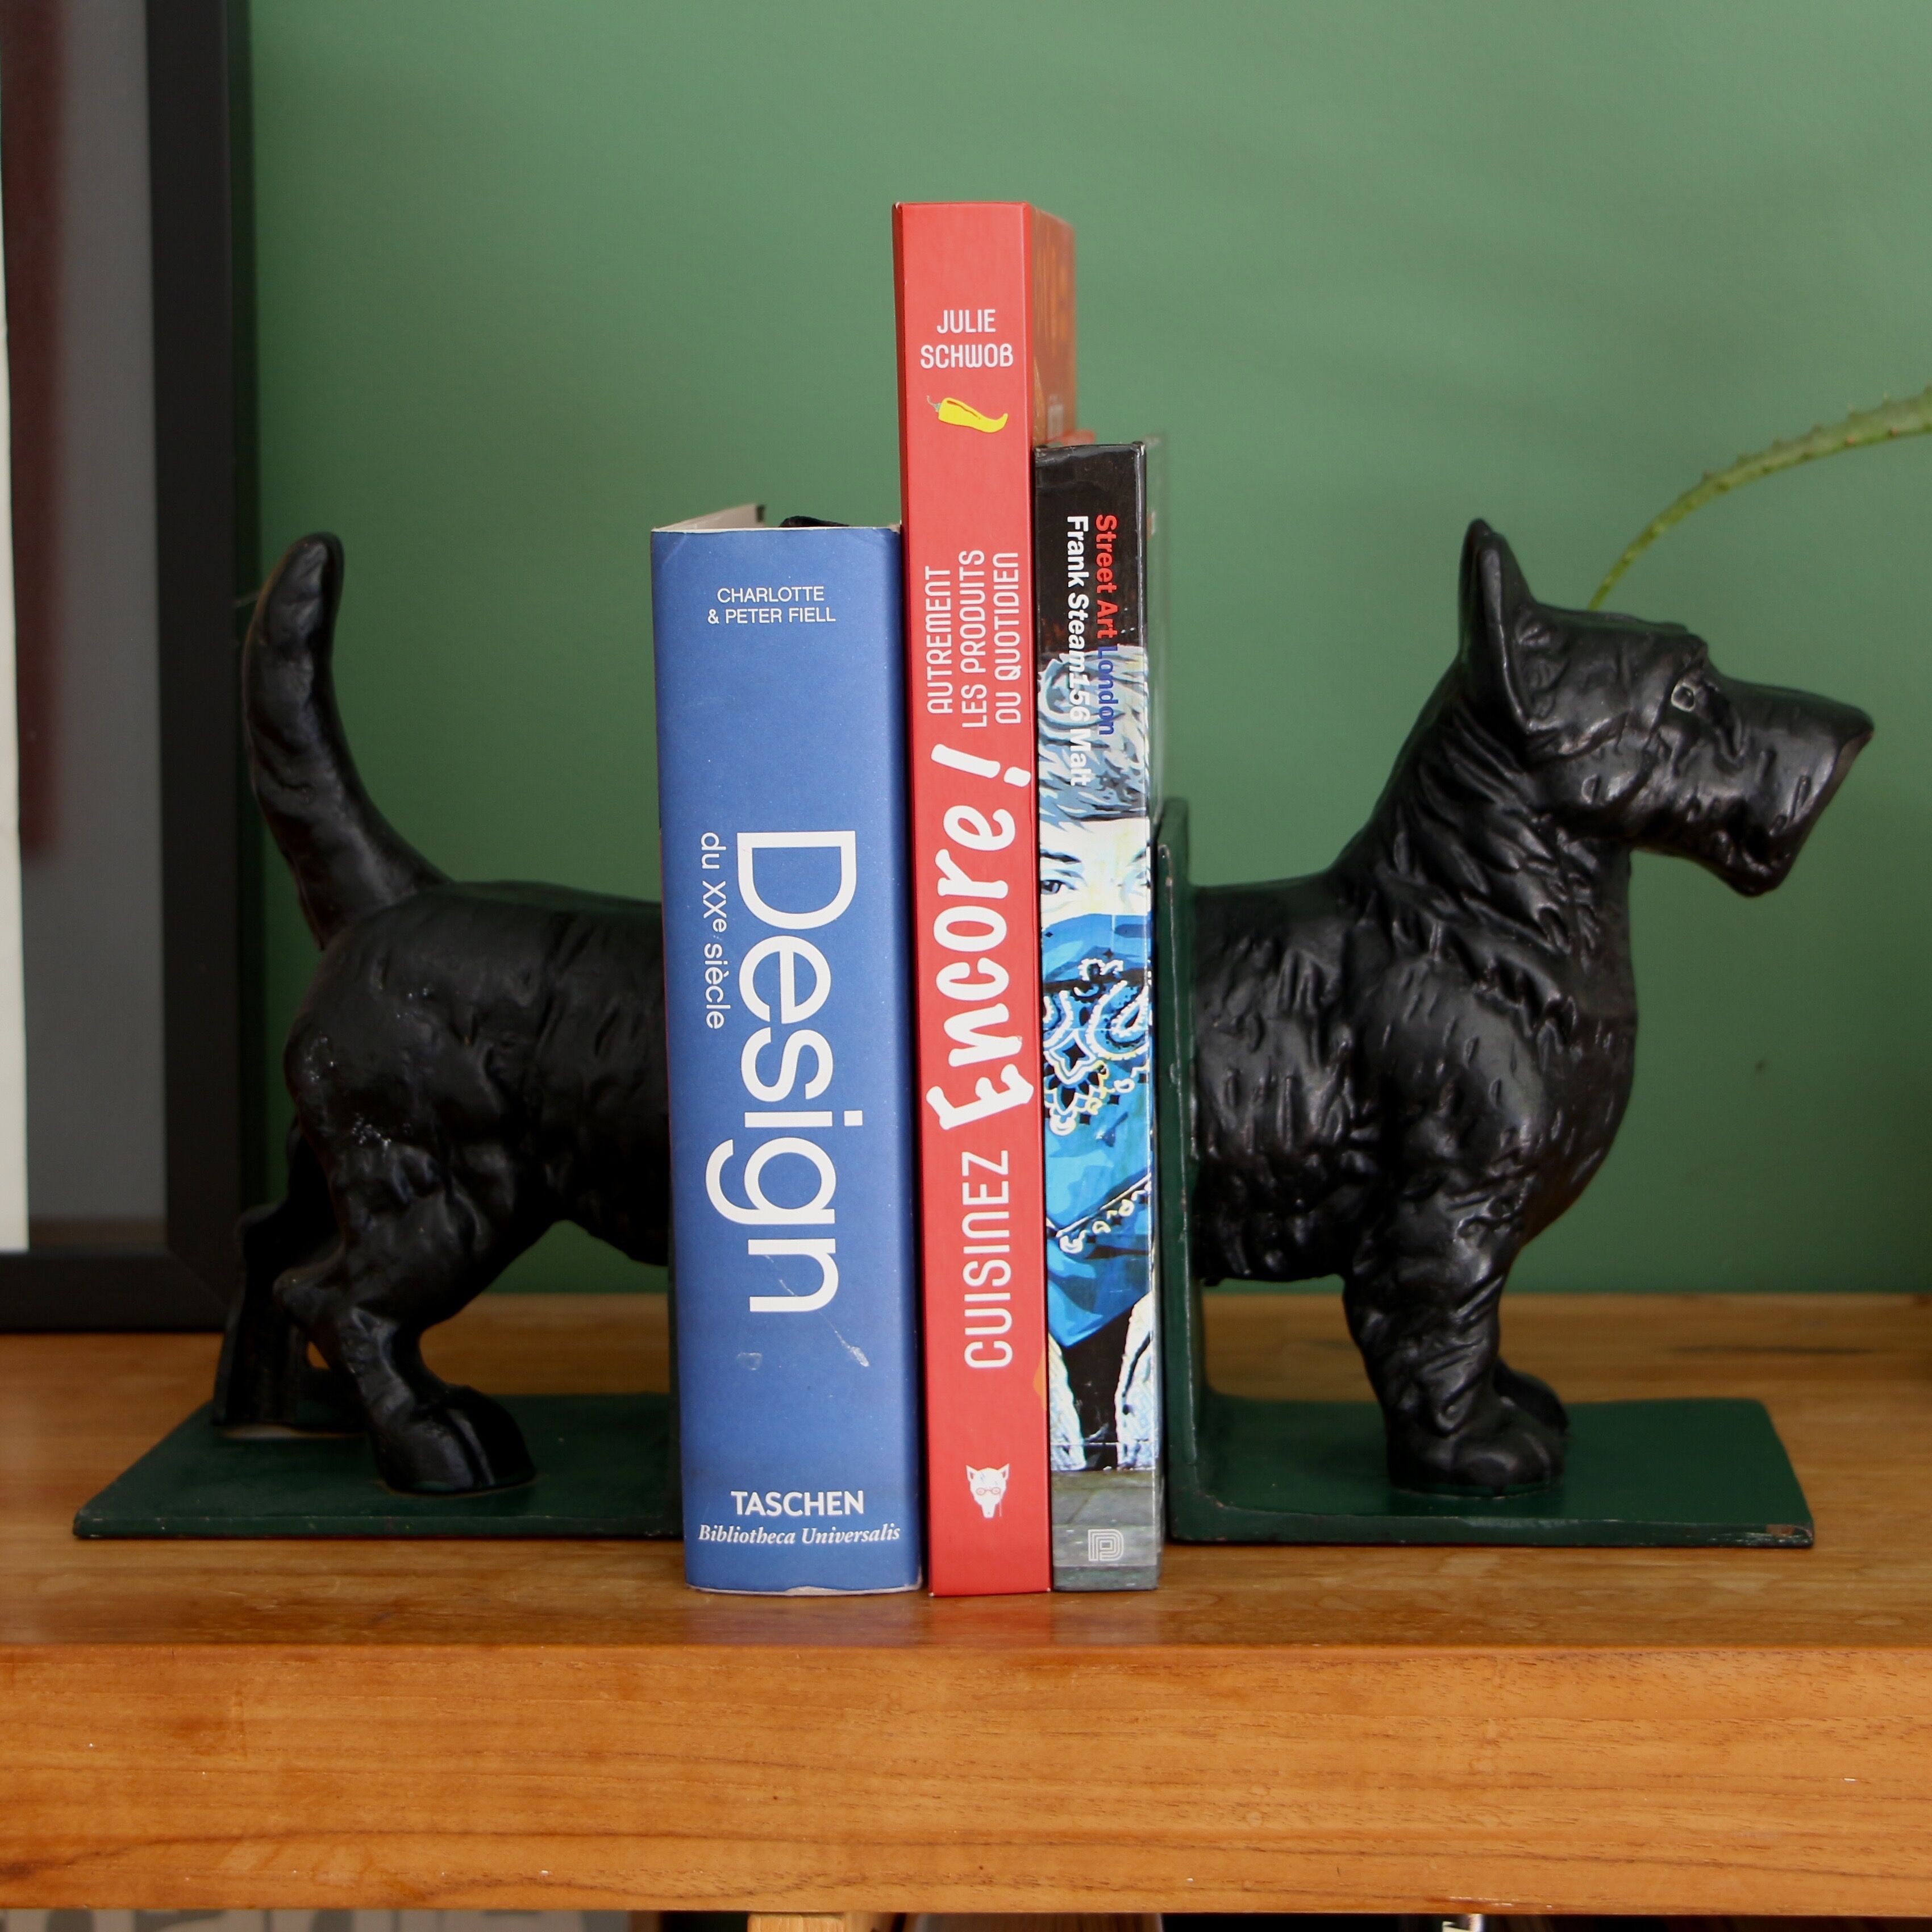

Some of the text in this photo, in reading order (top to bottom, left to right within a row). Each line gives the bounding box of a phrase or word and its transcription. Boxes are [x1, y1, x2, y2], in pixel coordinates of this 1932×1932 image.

[920, 343, 1014, 369] SCHWOB
[936, 309, 996, 334] JULIE
[707, 607, 836, 624] & PETER FIELL
[717, 586, 825, 603] CHARLOTTE
[958, 549, 987, 727] LES PRODUITS
[992, 552, 1022, 724] DU QUOTIDIEN
[1095, 514, 1119, 735] Street Art London
[925, 565, 953, 714] AUTREMENT
[1067, 515, 1091, 786] Frank Steam156 Malt
[701, 832, 726, 869] du
[704, 943, 731, 1030] siècle
[705, 830, 864, 1313] Design
[960, 1150, 1013, 1369] CUISINEZ
[698, 1522, 901, 1545] Bibliotheca Universalis
[730, 1490, 864, 1516] TASCHEN
